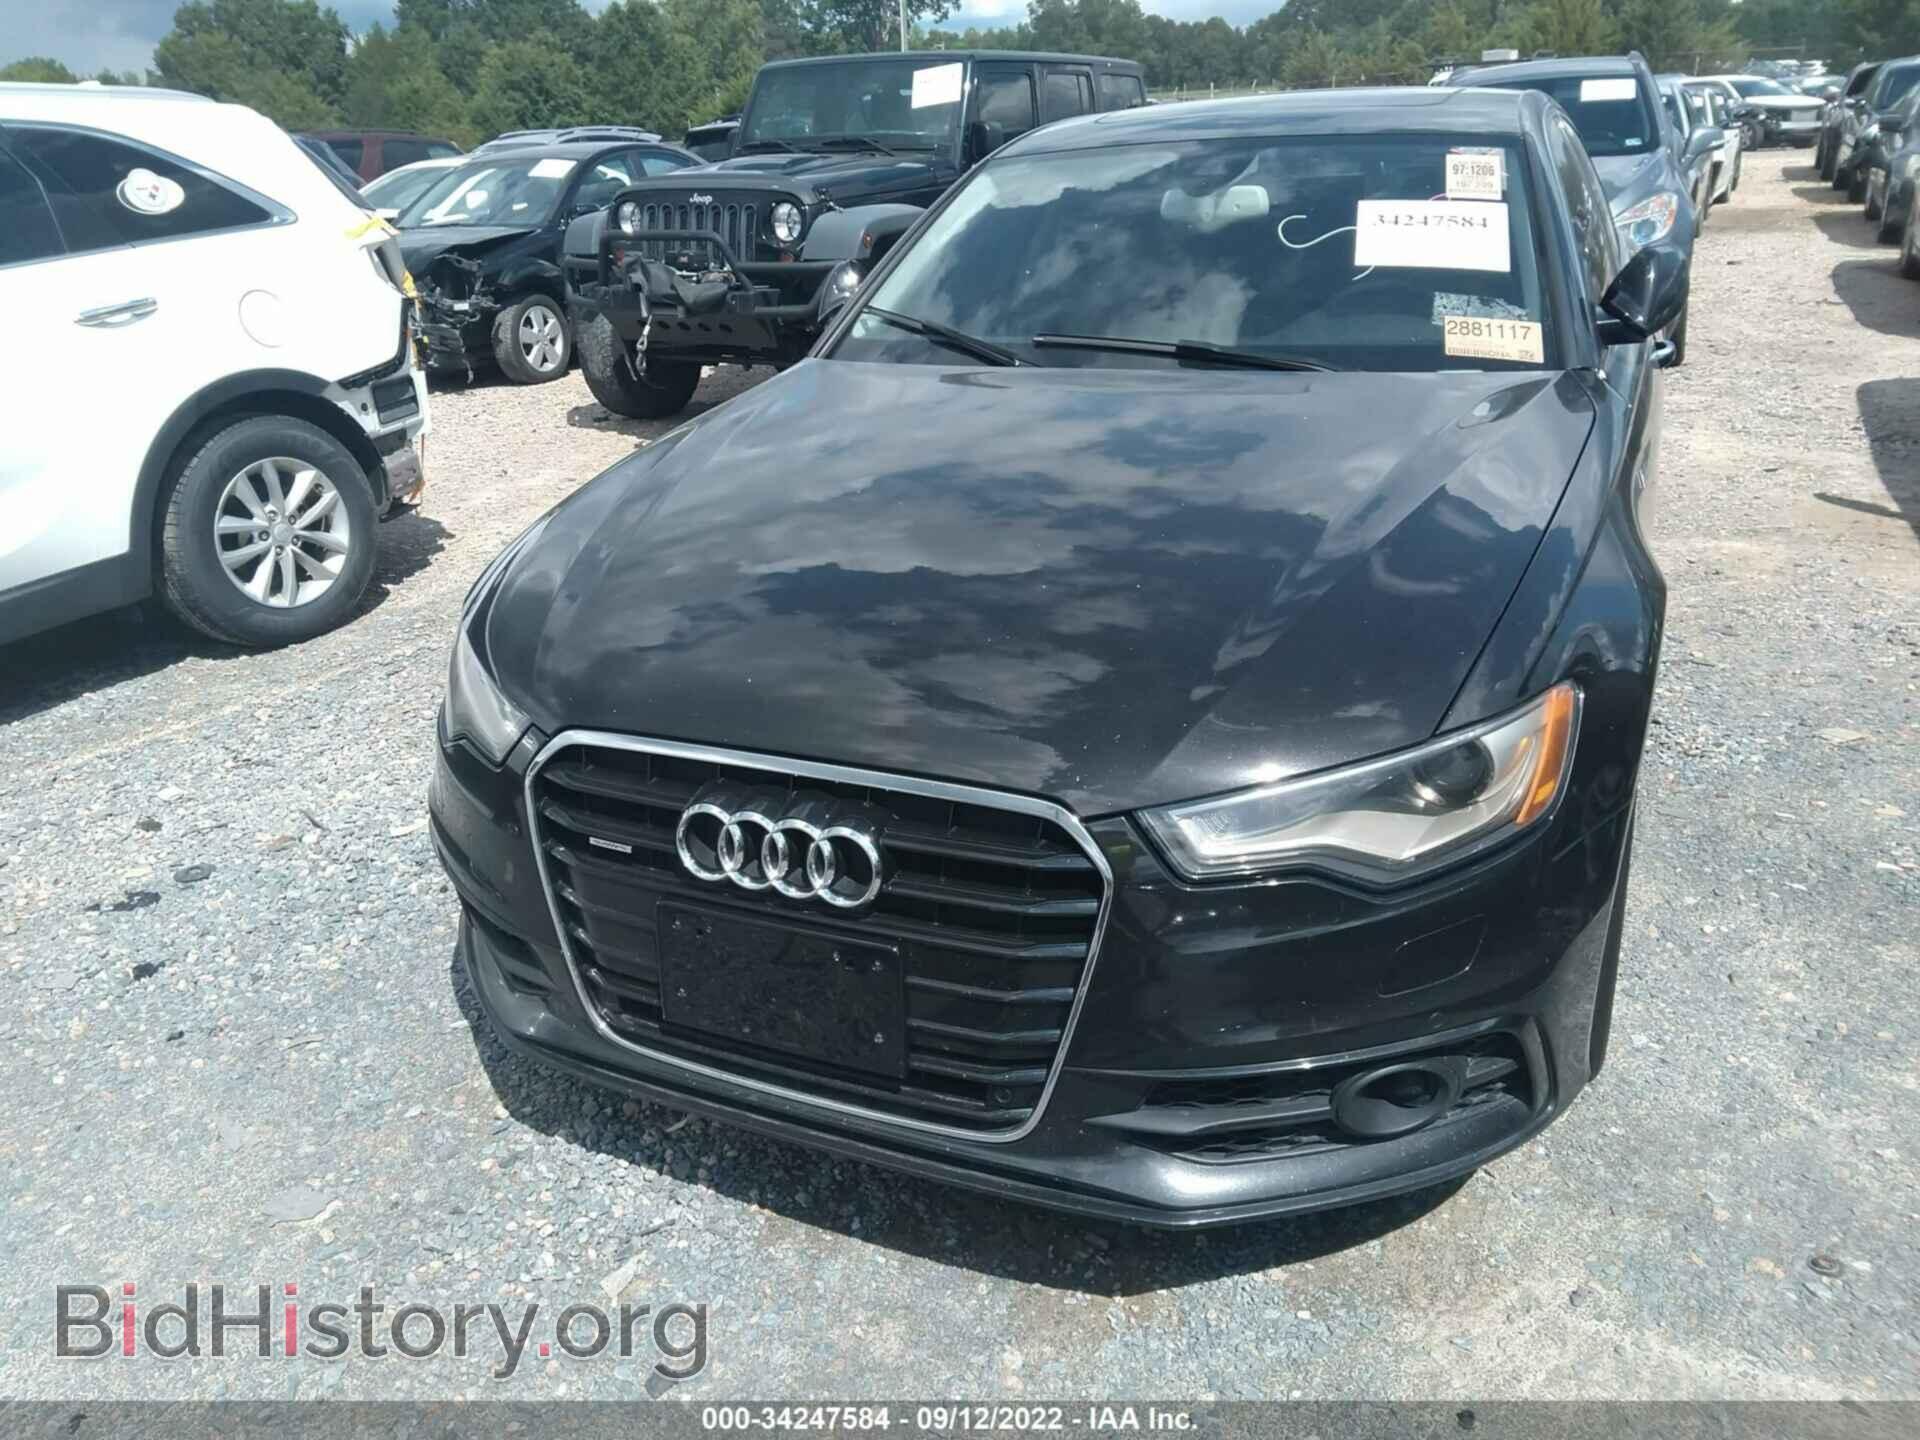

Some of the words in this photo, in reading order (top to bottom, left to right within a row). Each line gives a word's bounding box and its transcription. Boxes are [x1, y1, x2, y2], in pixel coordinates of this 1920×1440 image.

[689, 192, 712, 205] Jeep
[1372, 214, 1487, 228] 34247584
[1447, 320, 1531, 340] 2881117
